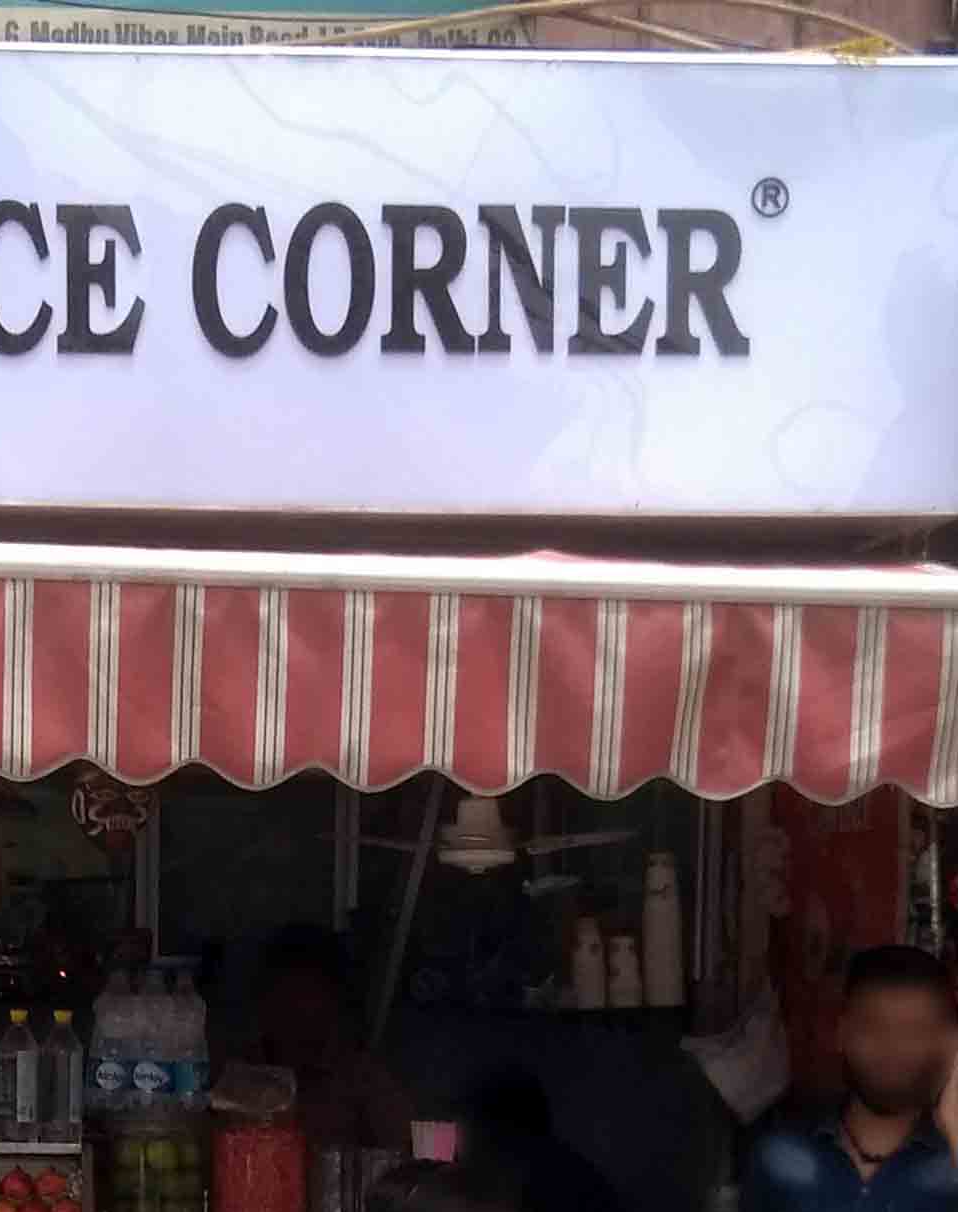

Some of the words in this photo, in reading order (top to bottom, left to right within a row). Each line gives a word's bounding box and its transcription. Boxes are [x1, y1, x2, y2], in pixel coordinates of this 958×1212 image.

[29, 20, 109, 44] Madhu
[114, 23, 178, 45] Vihar
[186, 23, 243, 46] Main
[192, 201, 751, 358] CORNER
